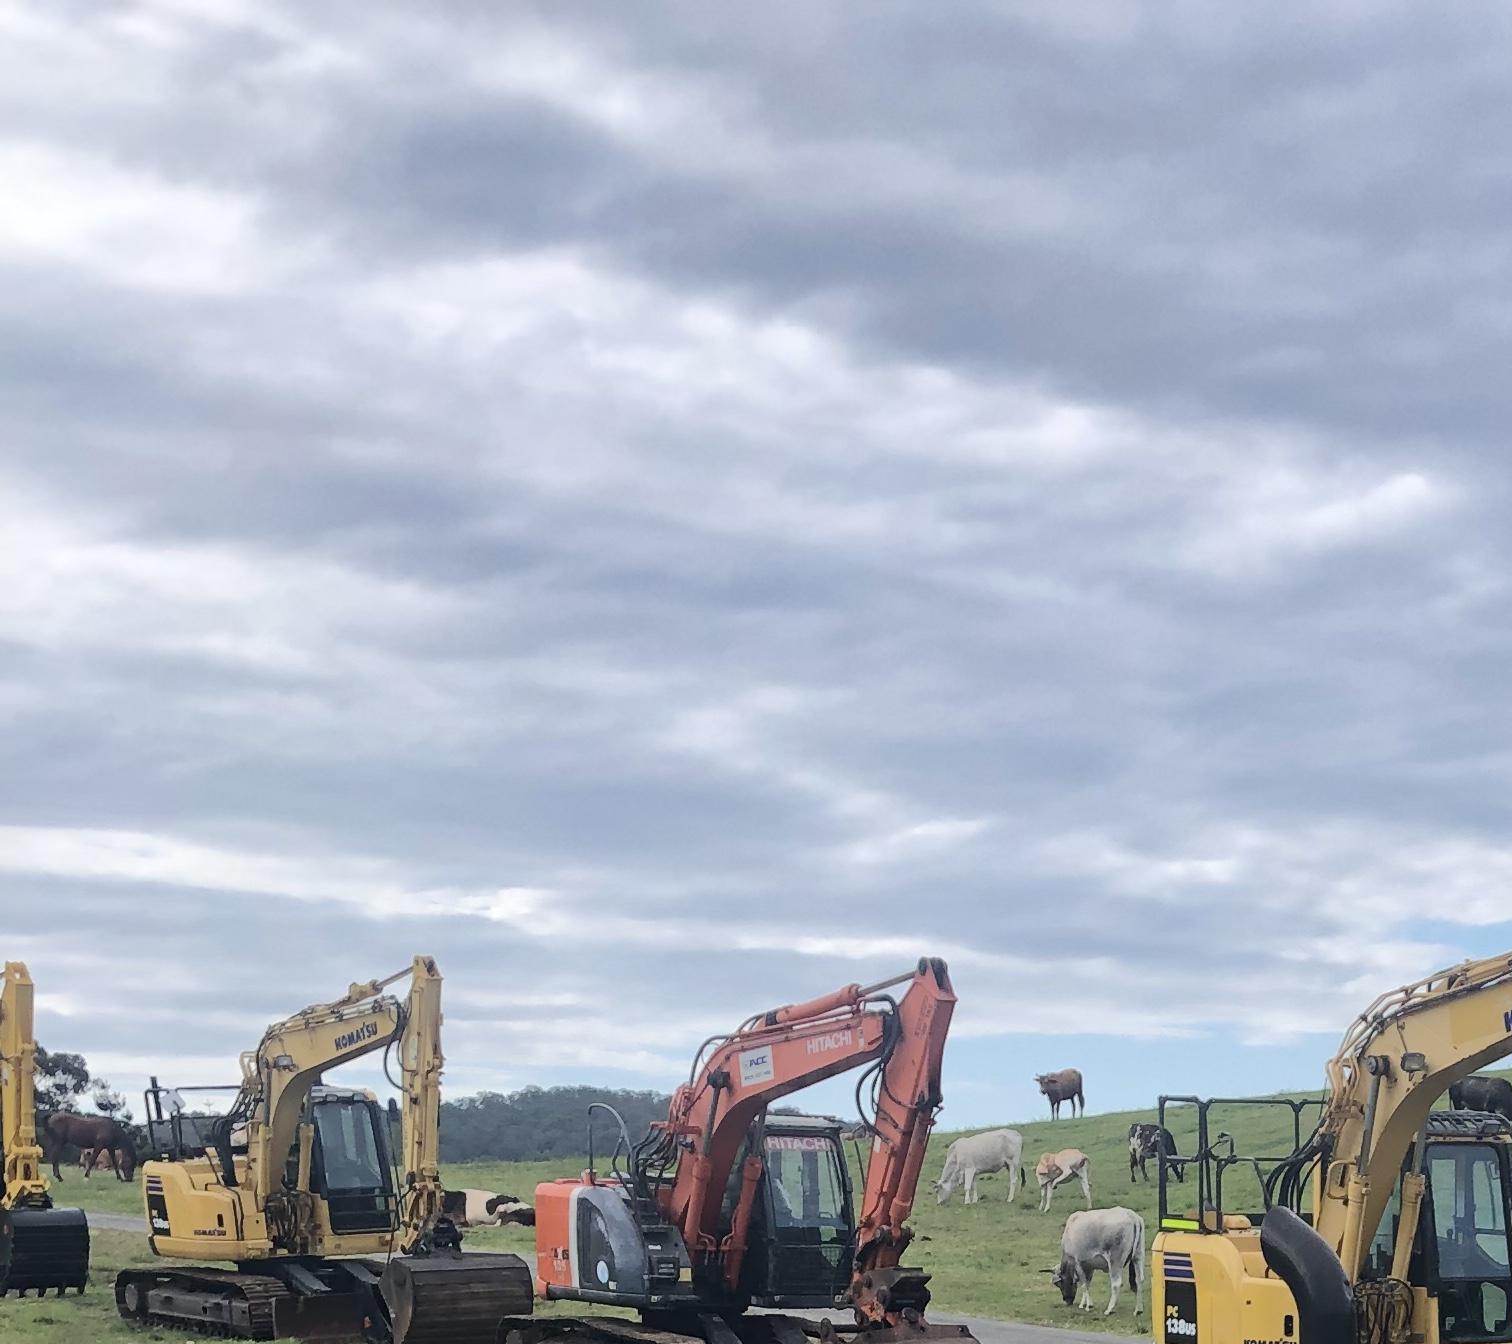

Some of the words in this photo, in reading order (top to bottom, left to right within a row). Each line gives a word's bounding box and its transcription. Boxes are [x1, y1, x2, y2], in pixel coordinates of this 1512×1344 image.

[335, 1021, 378, 1051] KOMATSU
[807, 1030, 852, 1054] HITACHI
[766, 1136, 831, 1151] HITACHI
[1166, 1305, 1178, 1317] PC
